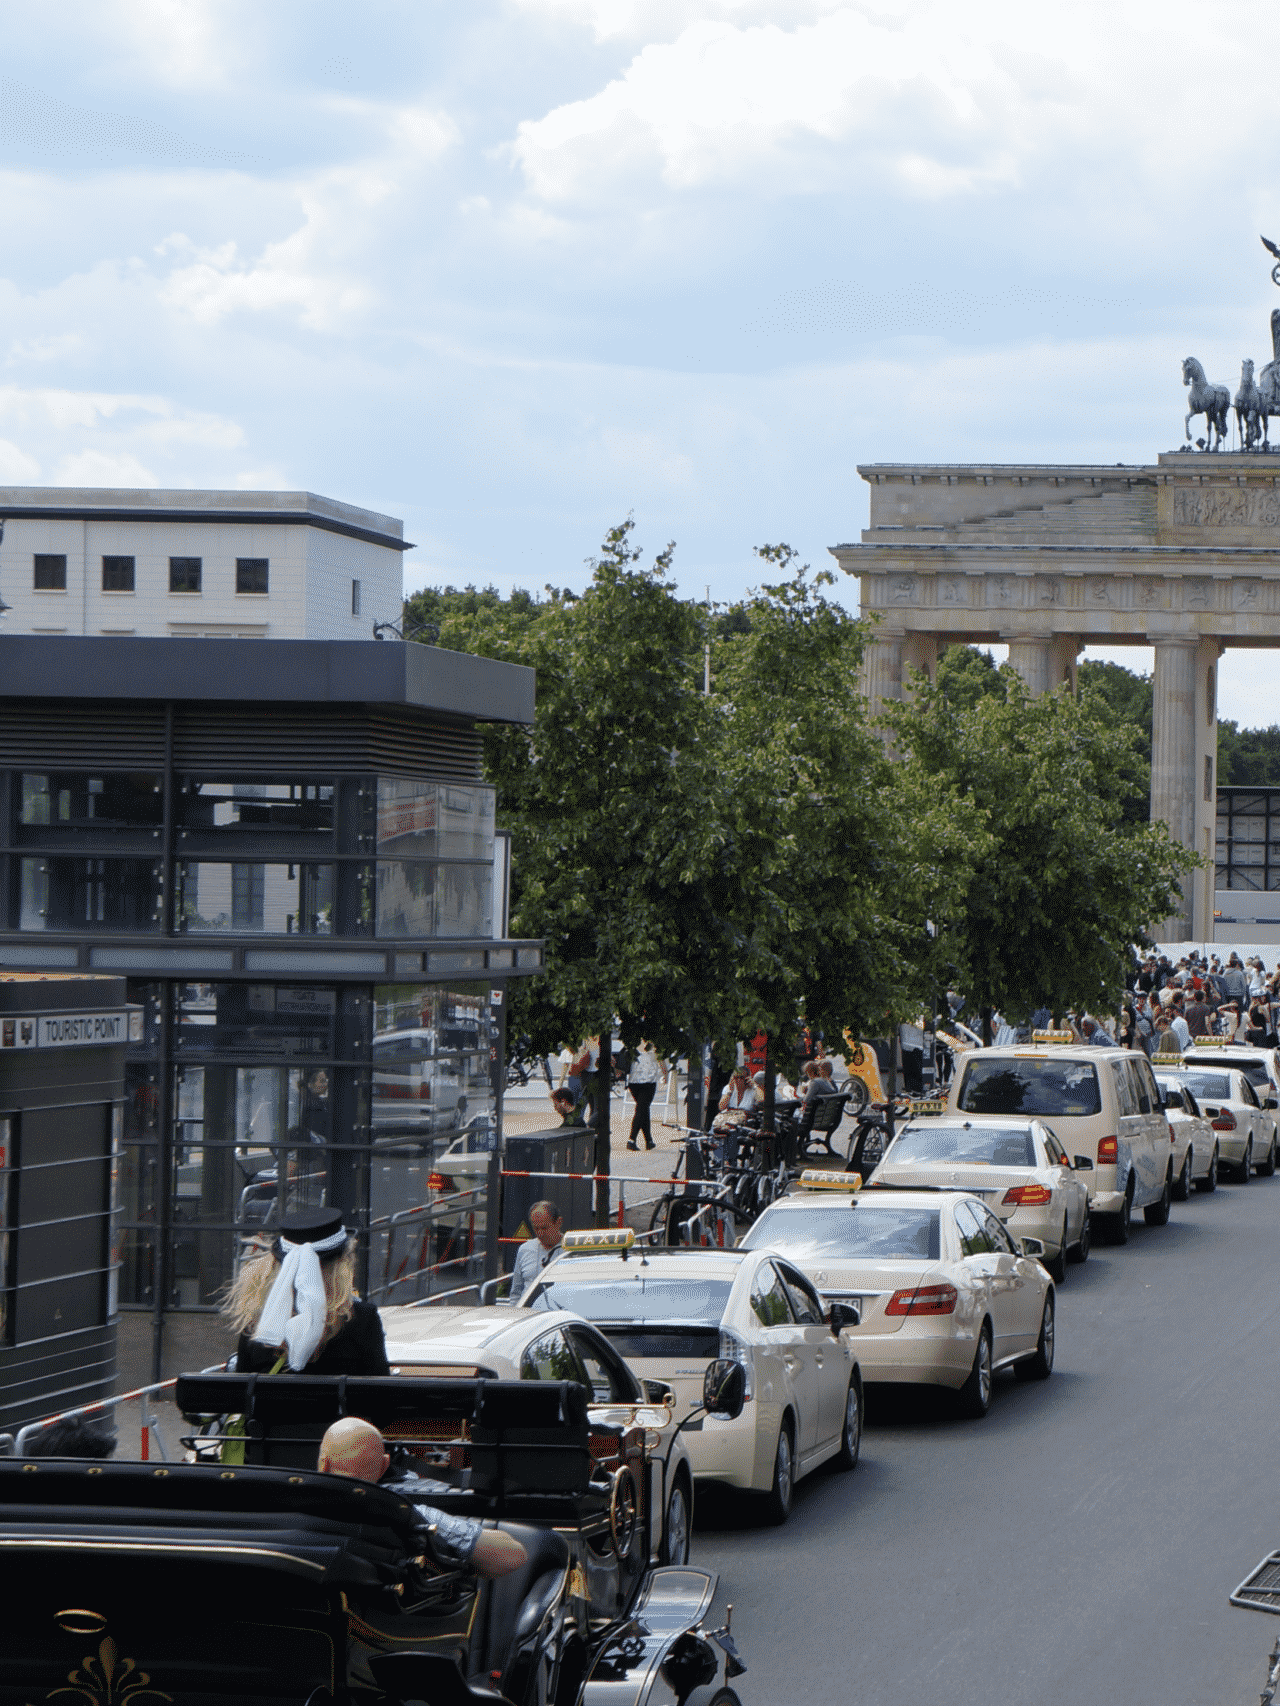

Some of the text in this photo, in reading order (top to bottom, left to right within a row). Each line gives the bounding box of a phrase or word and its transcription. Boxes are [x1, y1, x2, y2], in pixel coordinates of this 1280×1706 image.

[46, 1017, 120, 1041] TOURISTIC POINT
[811, 1172, 850, 1184] TAXI
[574, 1233, 620, 1245] TAXI
